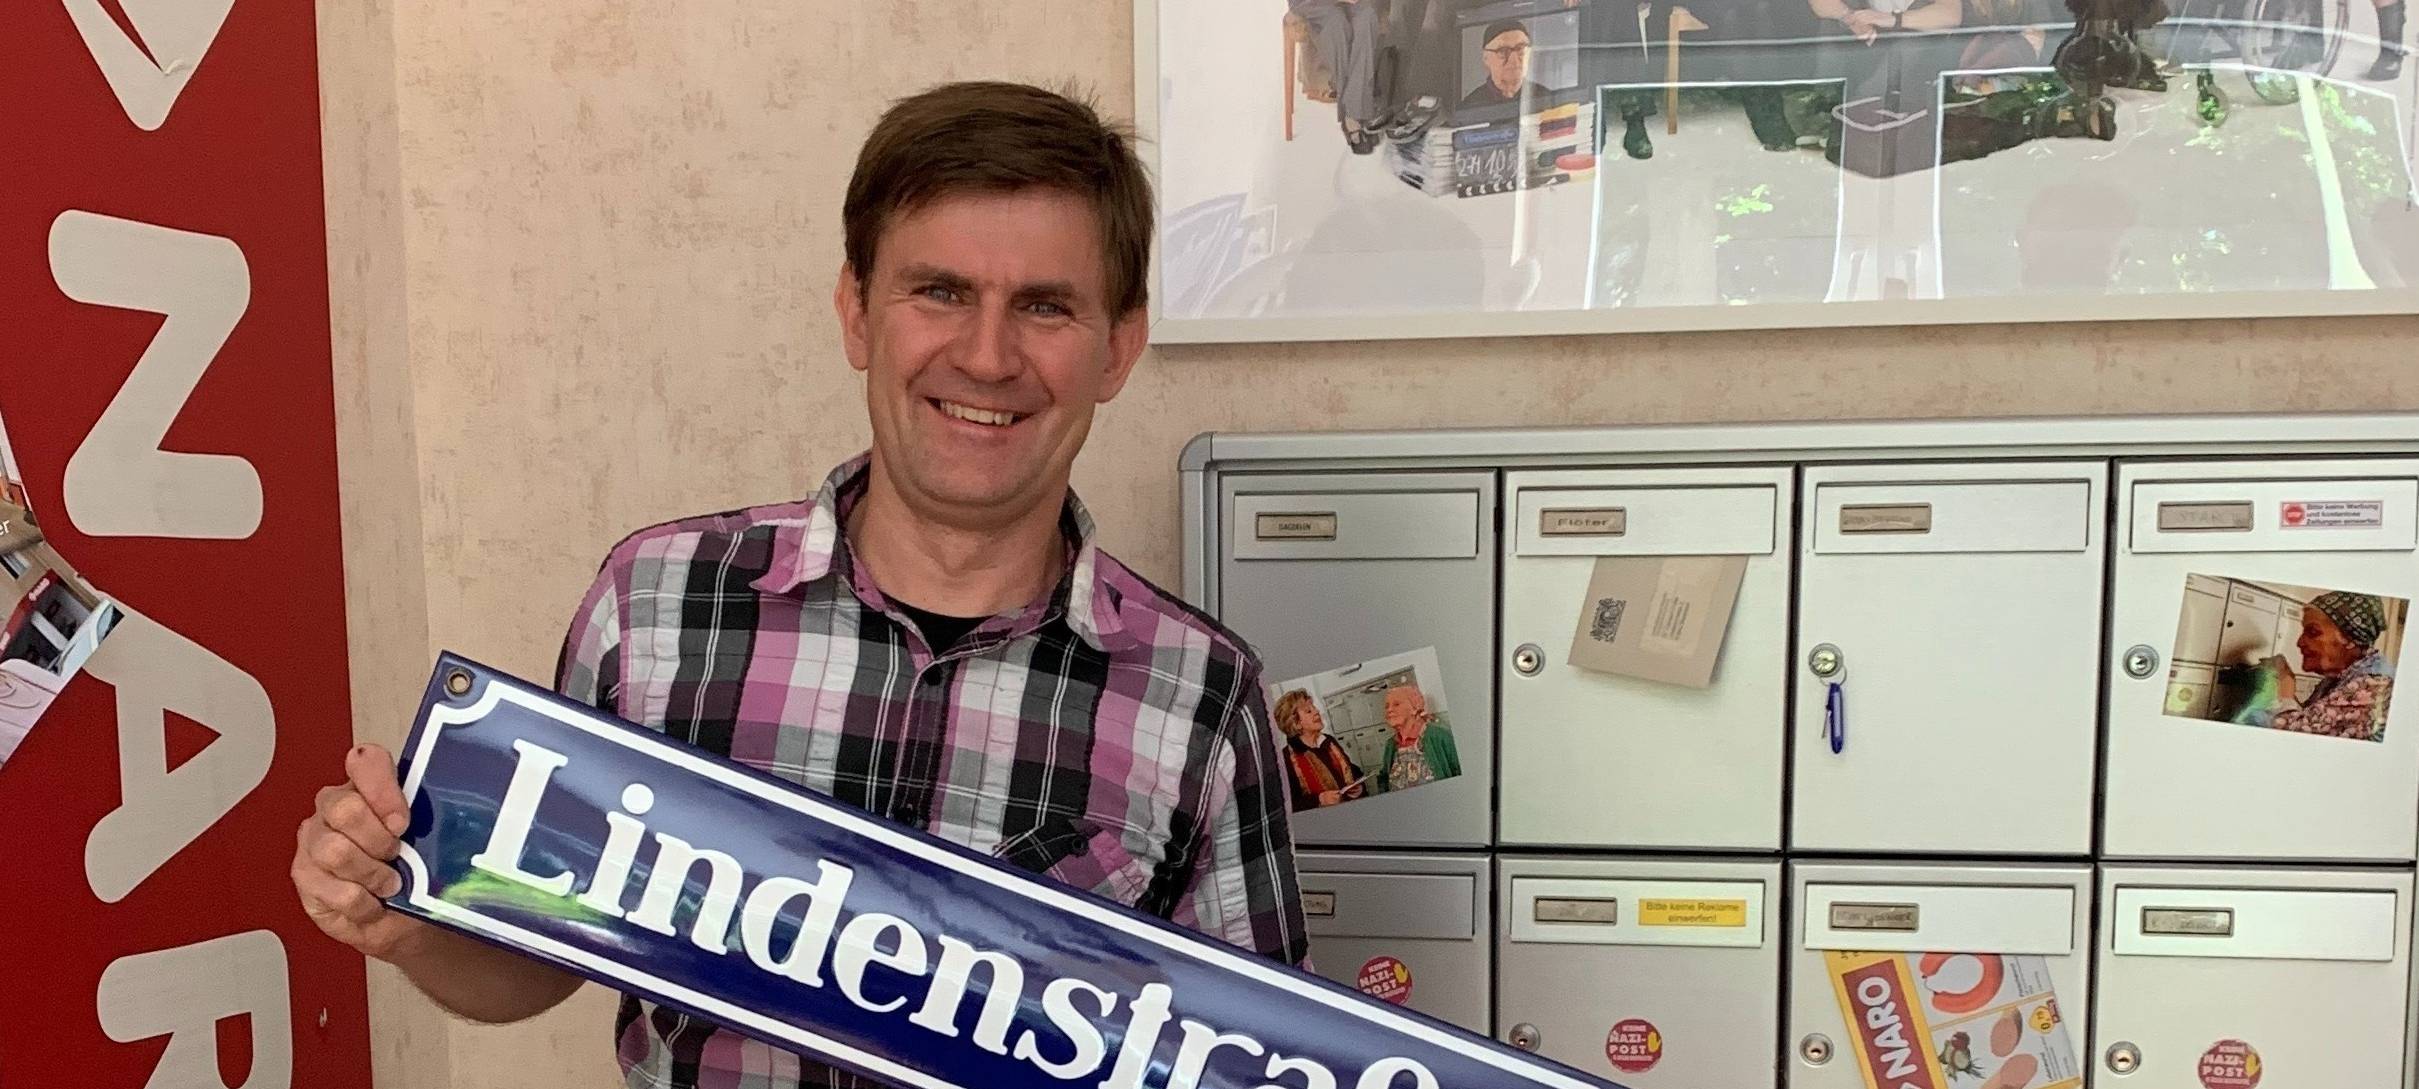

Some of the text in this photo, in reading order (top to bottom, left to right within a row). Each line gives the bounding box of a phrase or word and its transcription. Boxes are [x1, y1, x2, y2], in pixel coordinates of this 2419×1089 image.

[1359, 969, 1394, 988] NAZI-
[1857, 976, 1918, 1079] NARO
[1609, 1032, 1647, 1043] NAZI-
[1609, 1044, 1647, 1055] POST
[2203, 1054, 2245, 1066] NAZI-
[2202, 1065, 2244, 1078] POST
